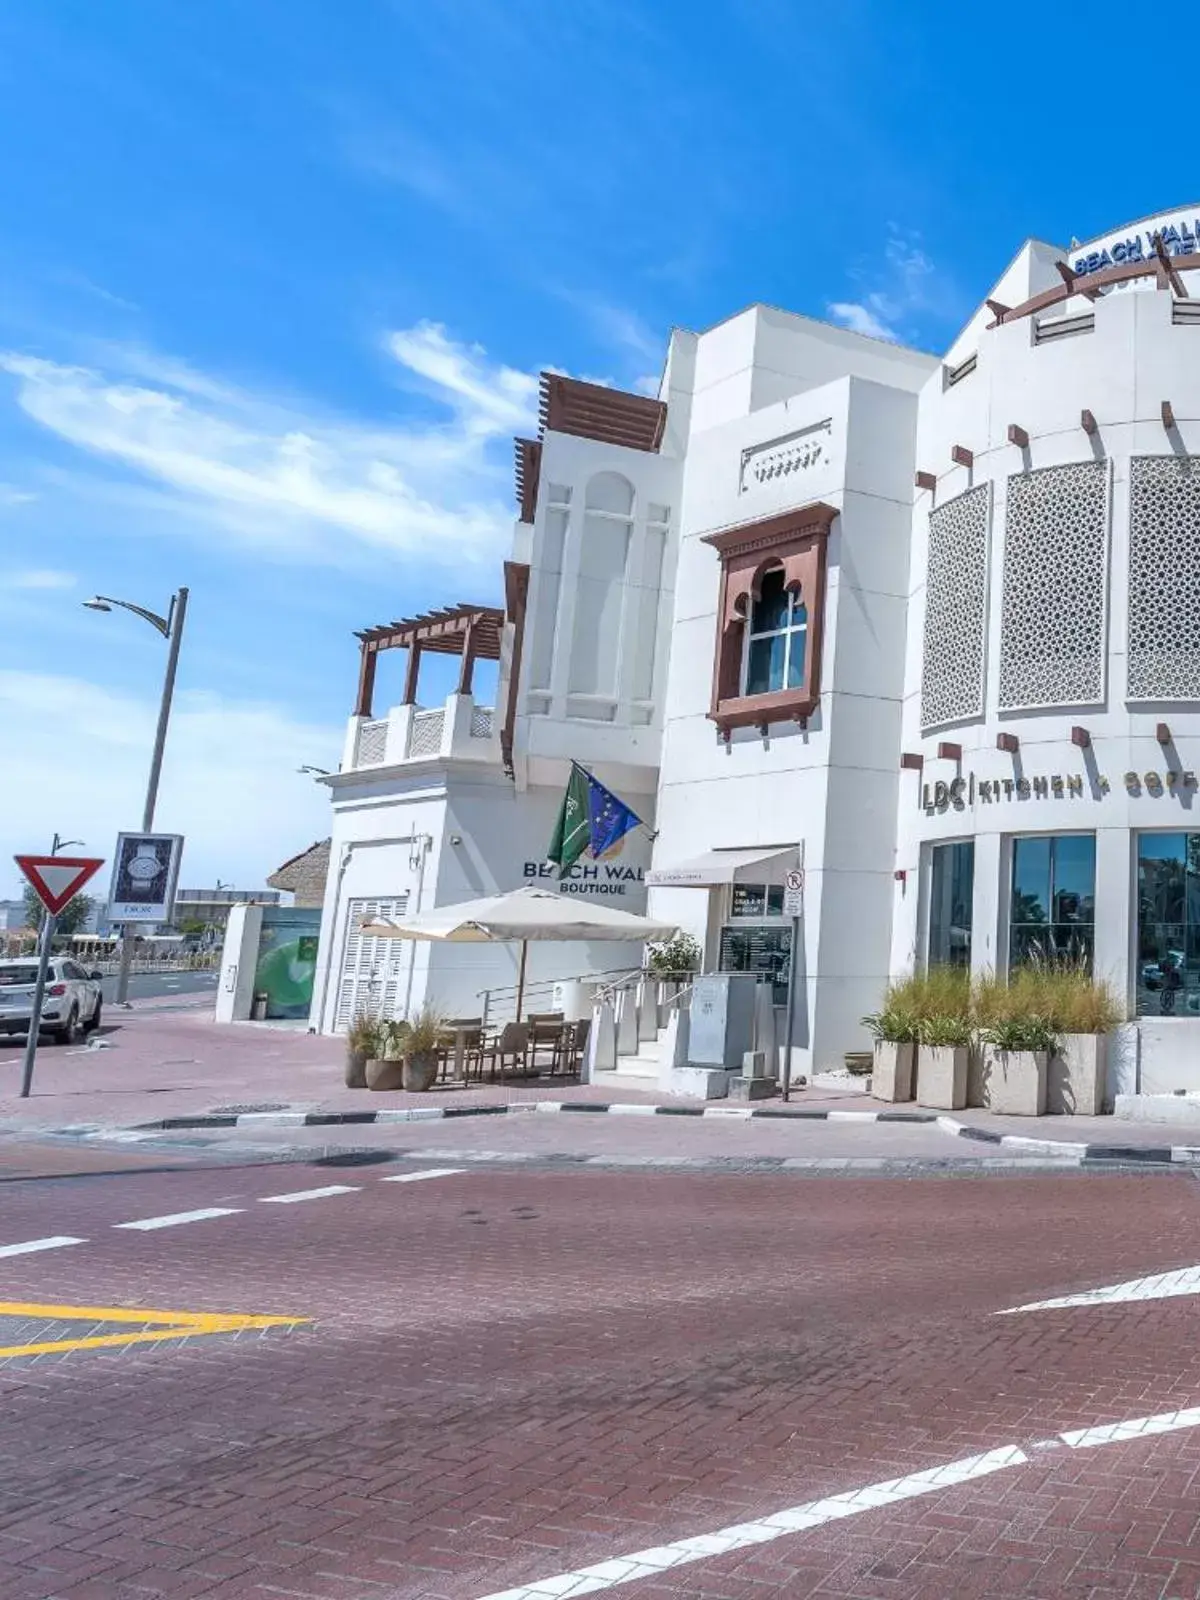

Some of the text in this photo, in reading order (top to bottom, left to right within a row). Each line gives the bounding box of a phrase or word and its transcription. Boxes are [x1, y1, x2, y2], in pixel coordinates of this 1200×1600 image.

[1075, 235, 1142, 276] BEACH
[923, 777, 966, 811] LDC
[979, 774, 1082, 797] KITCHEN
[523, 863, 598, 880] BECH
[559, 883, 627, 896] BOUTIQUE
